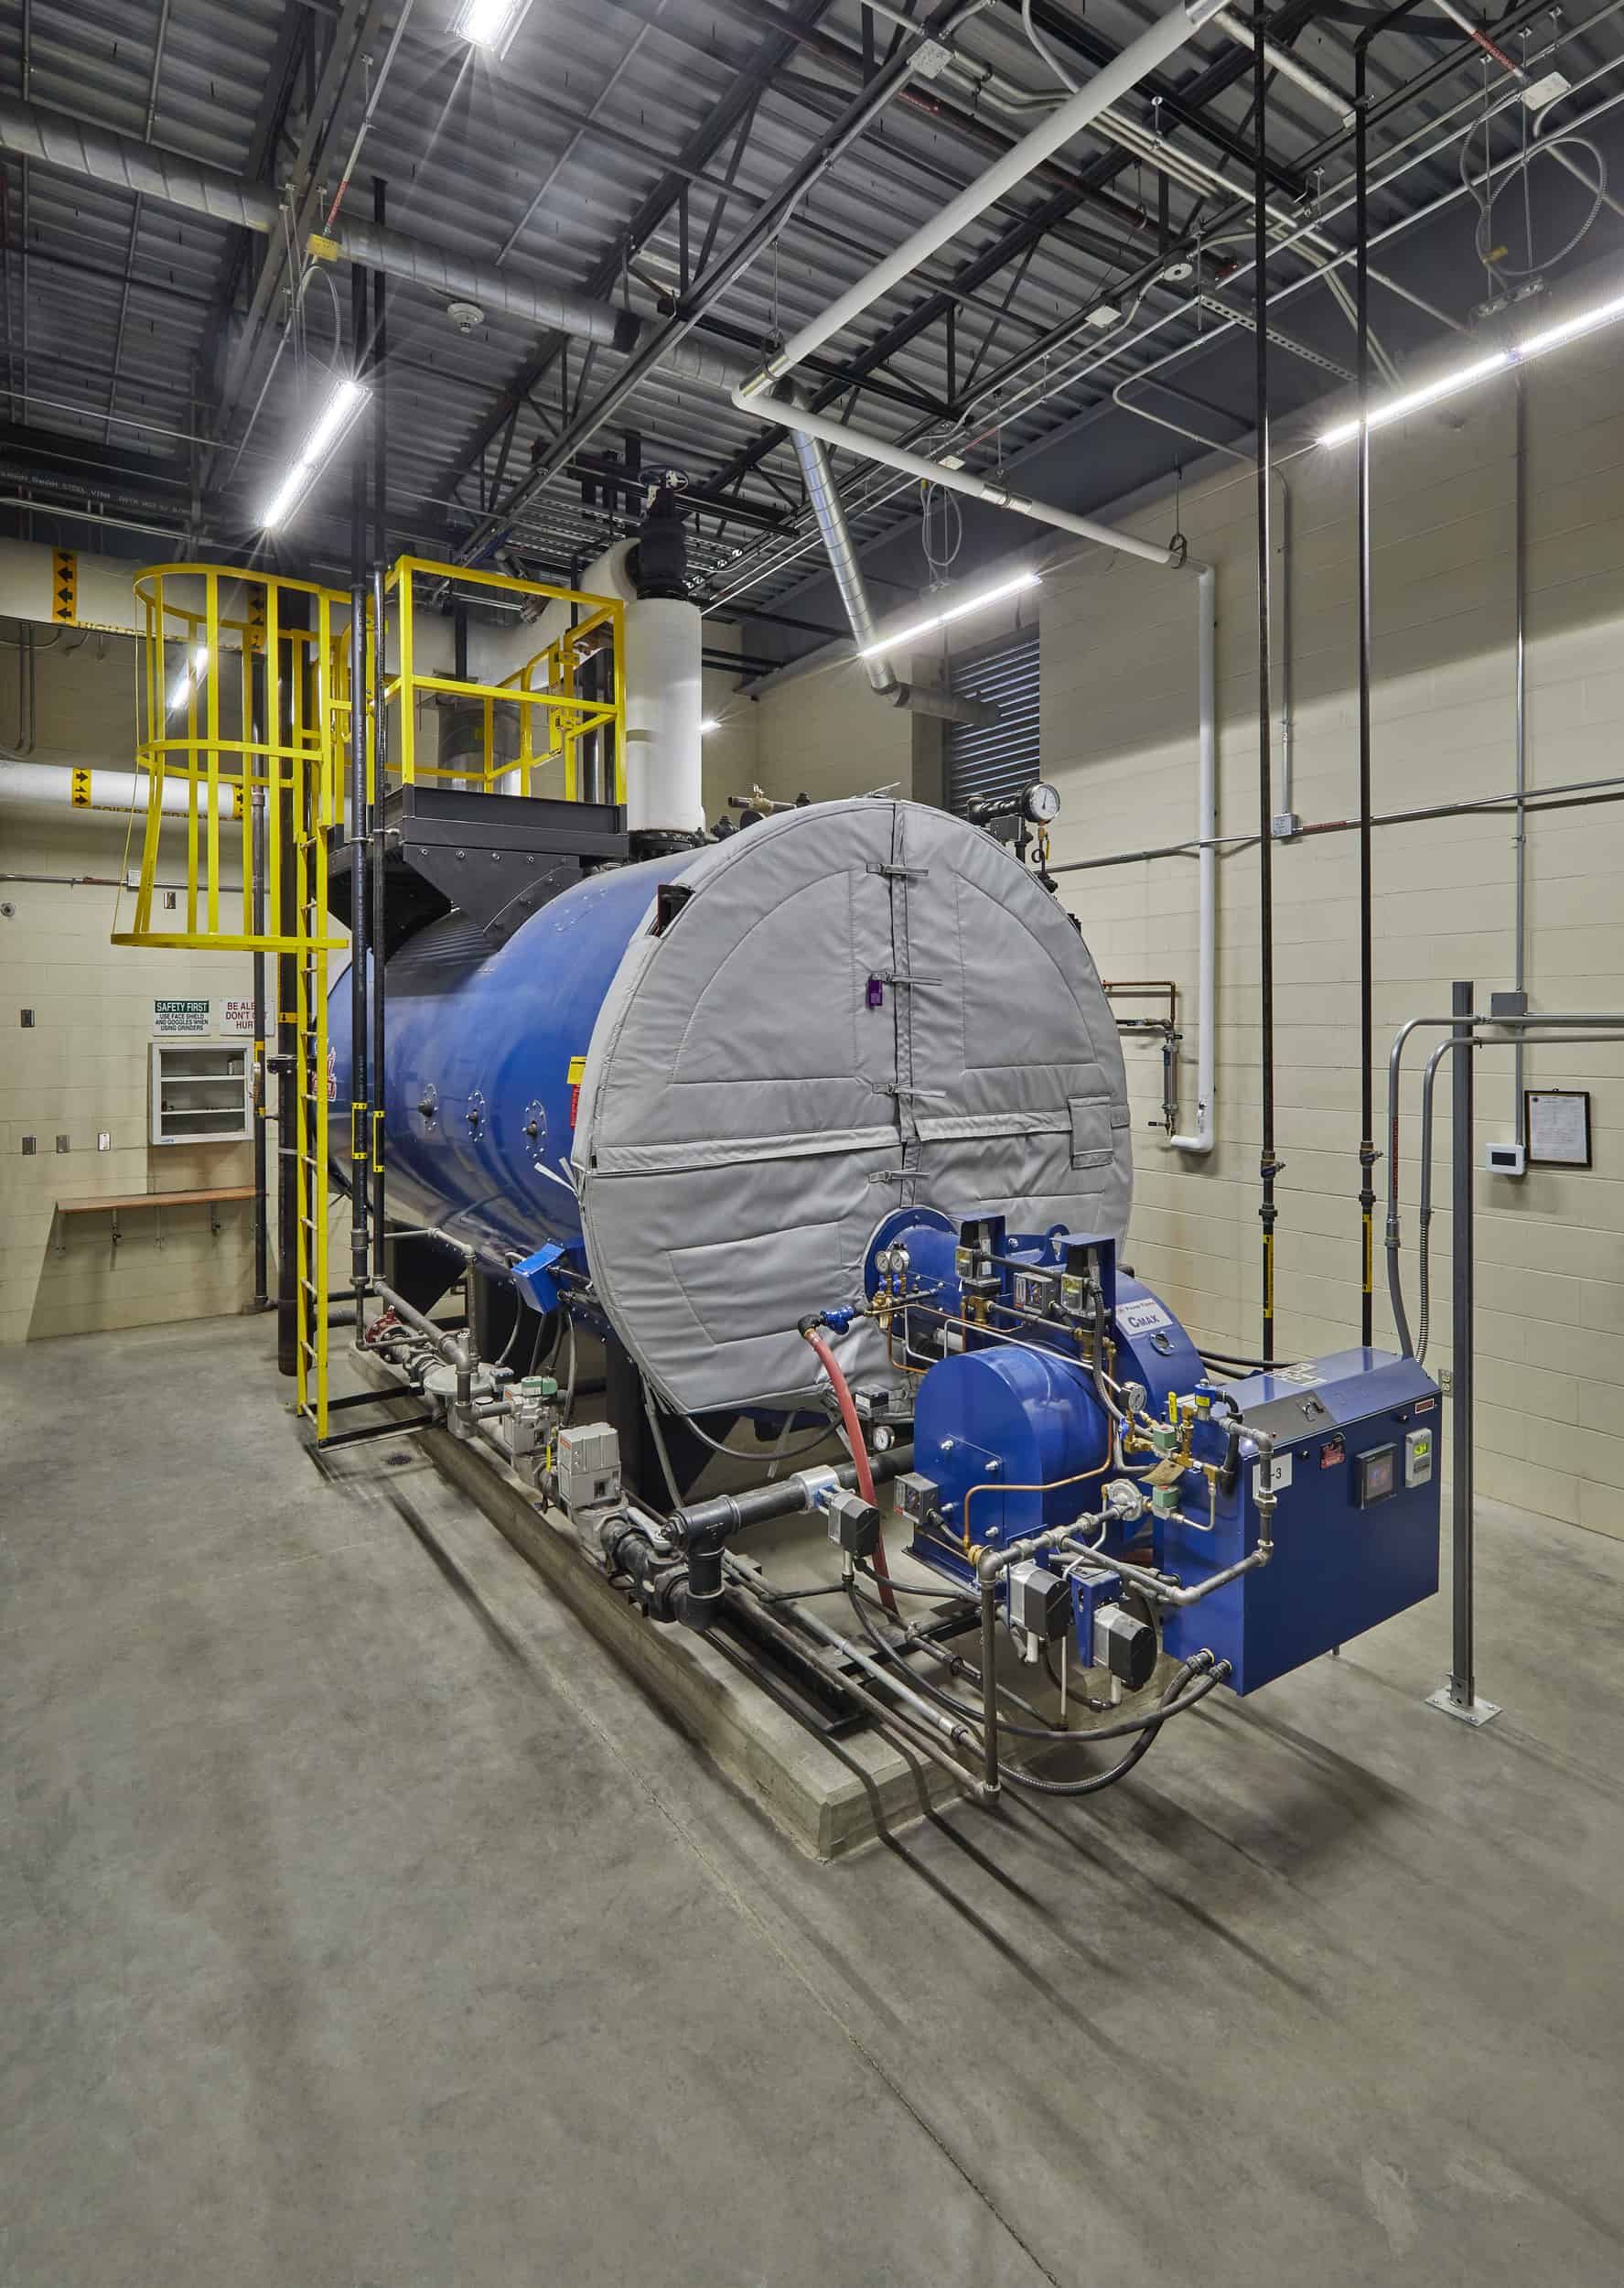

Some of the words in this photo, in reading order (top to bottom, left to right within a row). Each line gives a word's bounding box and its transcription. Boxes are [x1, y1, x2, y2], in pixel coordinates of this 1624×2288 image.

[156, 1002, 186, 1012] SAFETY
[187, 1002, 208, 1012] FIRST
[227, 1002, 238, 1010] BE
[241, 1002, 256, 1010] ALE
[226, 1011, 249, 1020] DON'T
[236, 1020, 253, 1030] HUR
